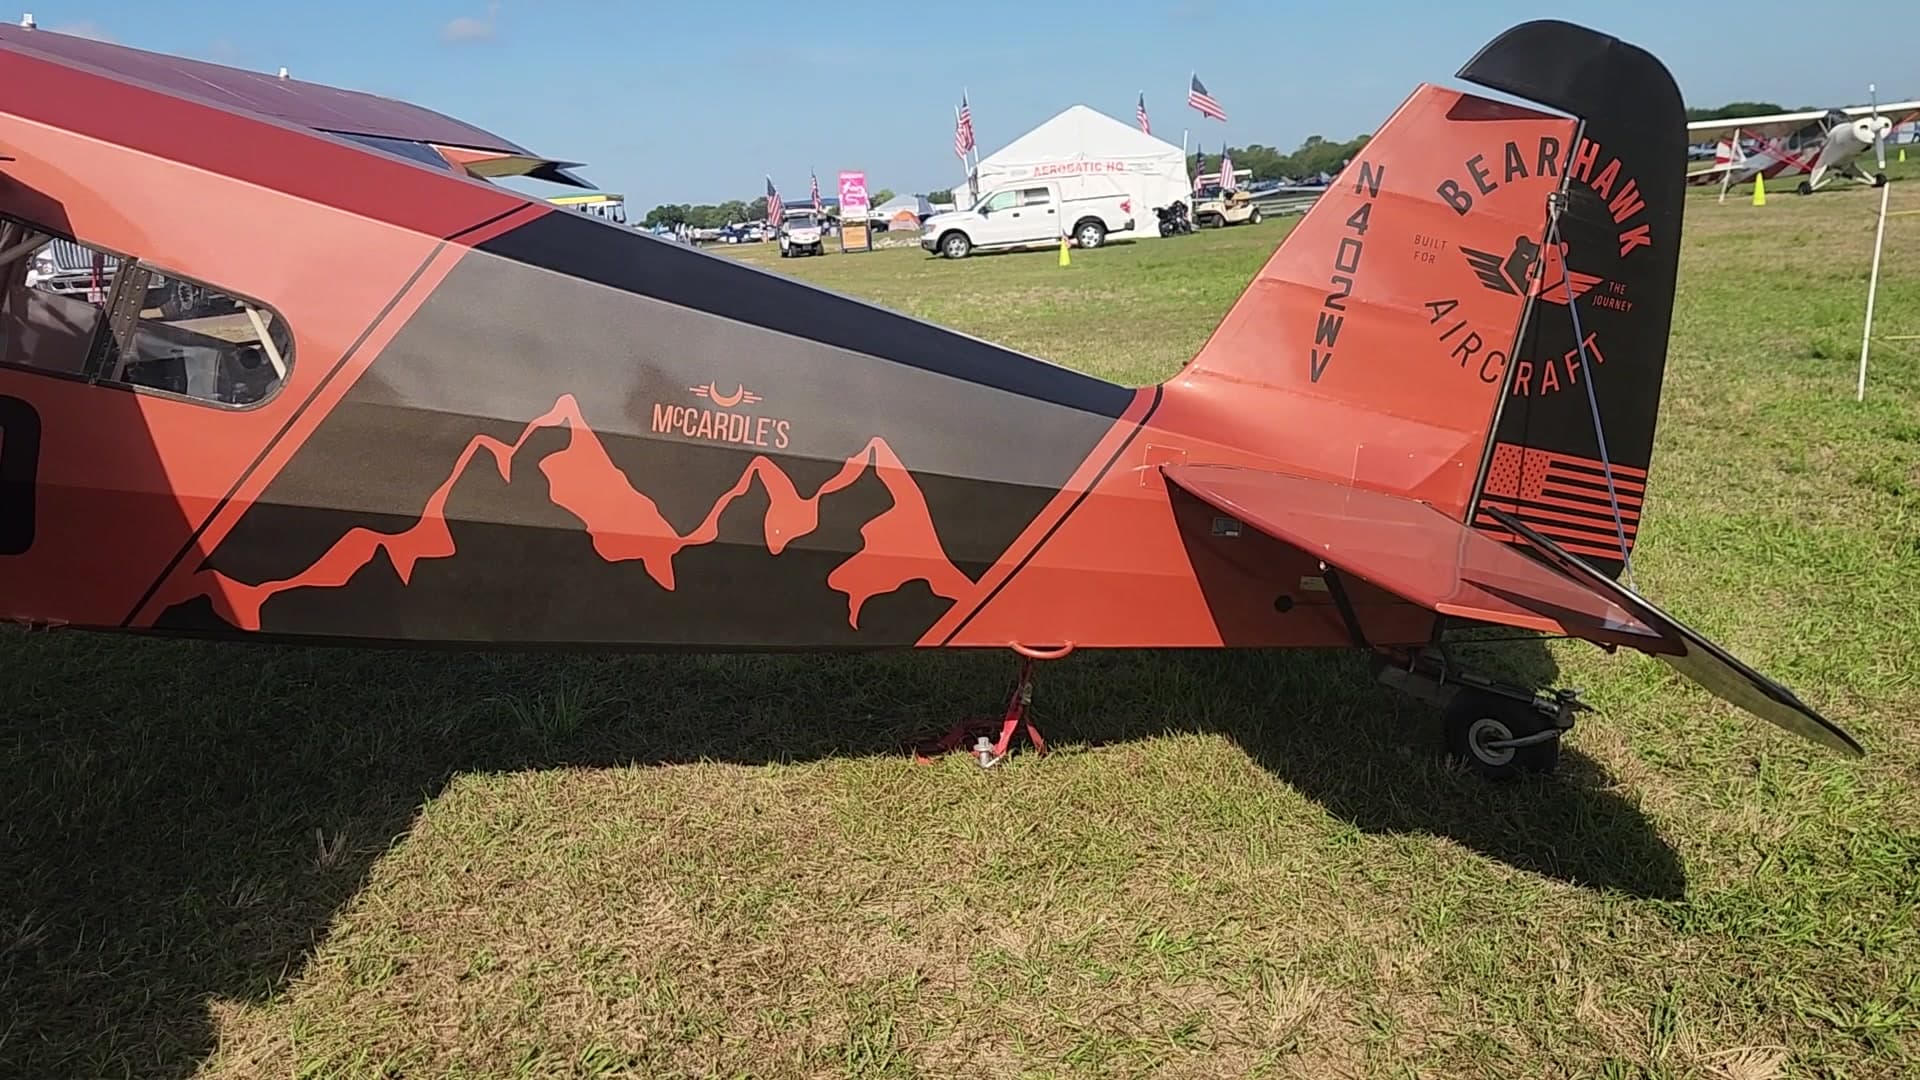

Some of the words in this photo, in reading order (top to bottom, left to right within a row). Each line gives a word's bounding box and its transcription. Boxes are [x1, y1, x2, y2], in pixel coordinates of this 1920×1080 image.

[1033, 161, 1102, 178] AEROBATIC
[1106, 161, 1125, 172] HQ
[1436, 136, 1652, 257] BEARHAWK
[1414, 234, 1449, 251] BUILT
[1414, 250, 1436, 264] FOR
[1310, 161, 1385, 384] N402WV
[1609, 281, 1628, 295] THE
[1592, 295, 1633, 312] JOURNEY
[1424, 299, 1606, 397] AIRCRAFT
